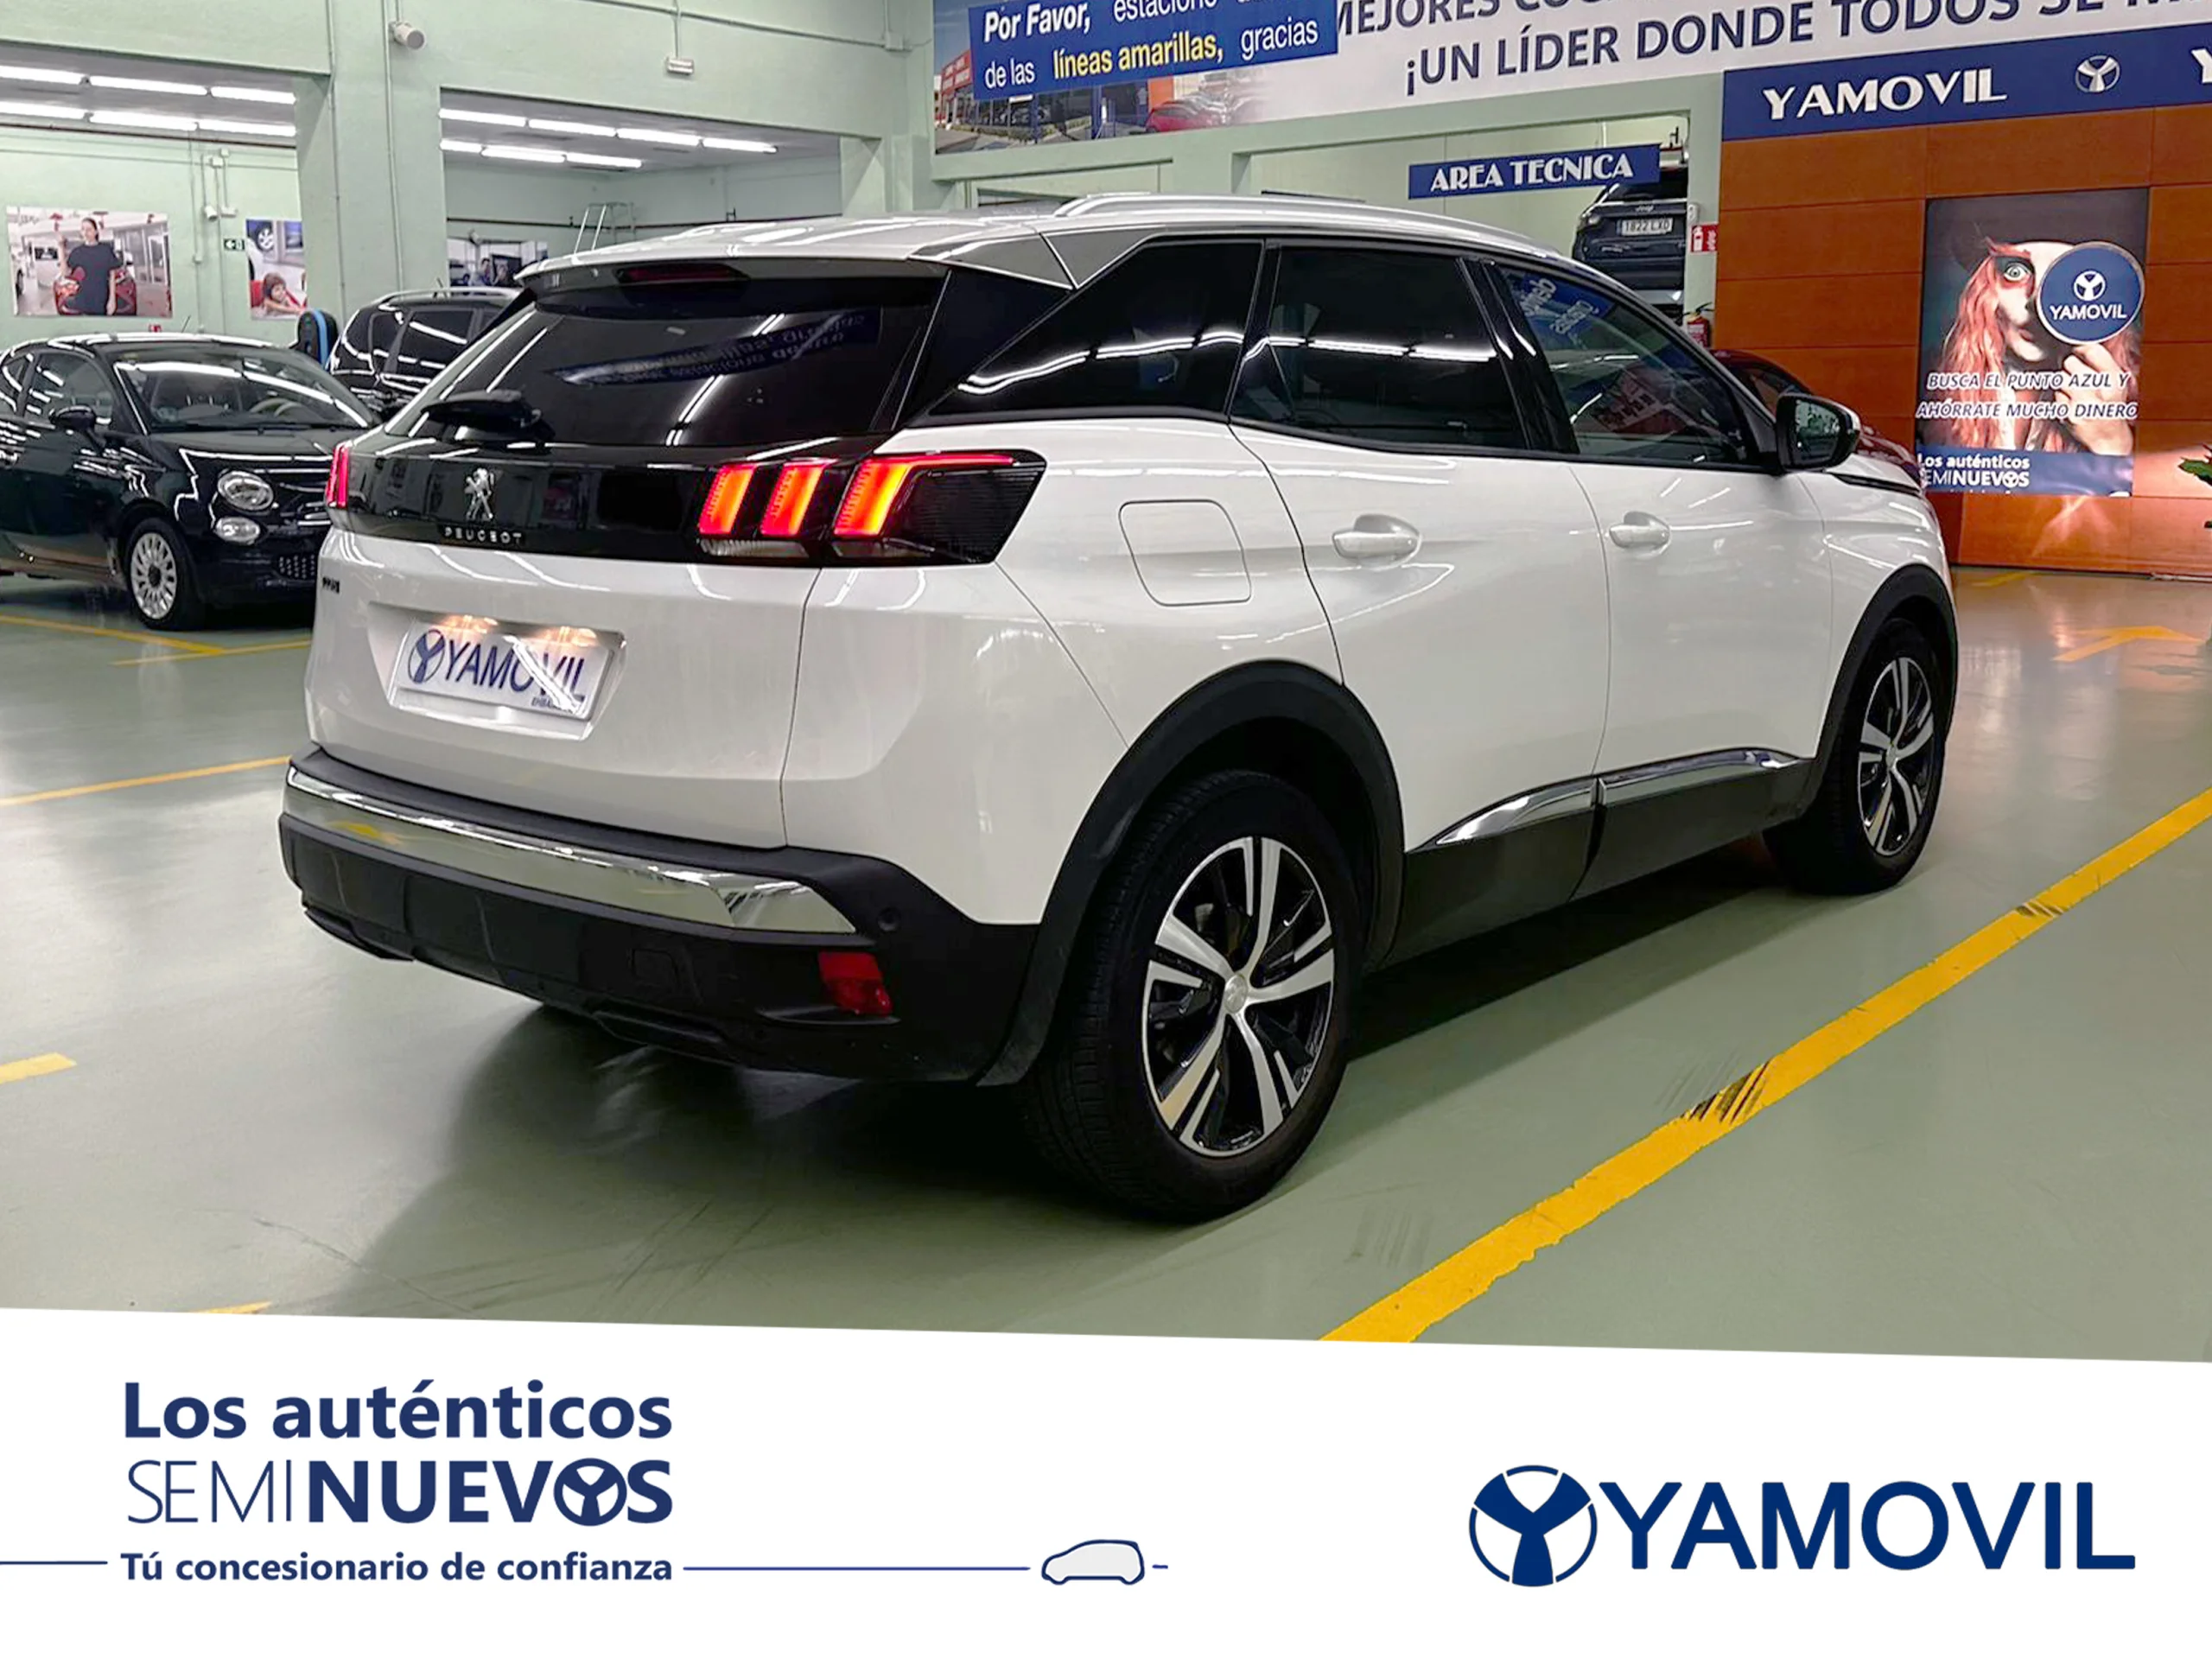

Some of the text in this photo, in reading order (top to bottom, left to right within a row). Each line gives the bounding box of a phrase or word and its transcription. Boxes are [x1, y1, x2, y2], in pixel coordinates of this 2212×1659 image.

[984, 10, 1021, 42] Por
[1026, 3, 1090, 35] Favor,
[985, 17, 1319, 89] de las líneas amarillas, gracias
[1407, 0, 2020, 95] ¡UN LÍDER DONDE TODOS
[1763, 68, 2007, 120] YAMOVIL
[1430, 153, 1634, 192] AREA TECNICA
[2050, 304, 2126, 321] YAMOVIL
[1928, 372, 2131, 389] BUSCA EL PUNTO AZUL Y
[1916, 398, 2139, 418] AHÓRRATE MUCHO DINERO
[1946, 454, 2031, 469] auténticos
[444, 526, 522, 544] PEUGEOT
